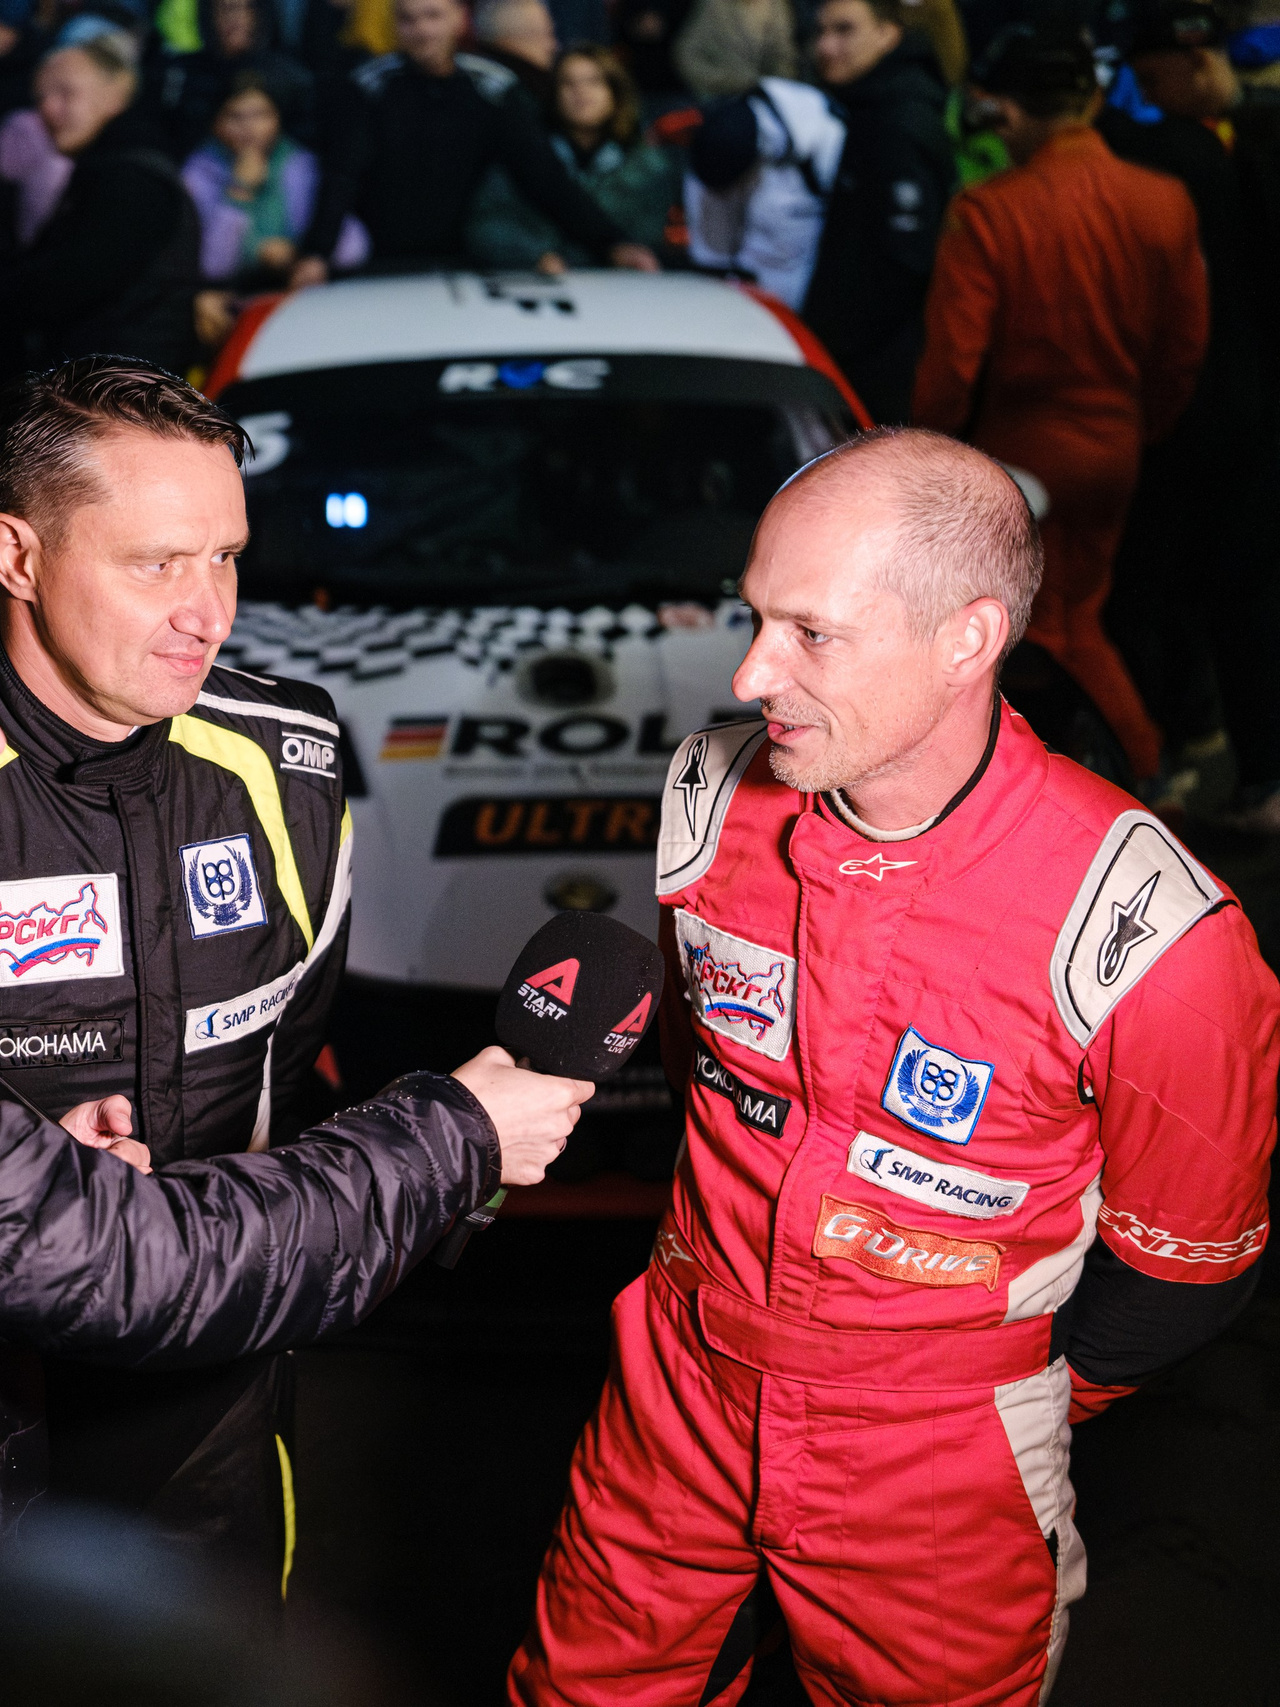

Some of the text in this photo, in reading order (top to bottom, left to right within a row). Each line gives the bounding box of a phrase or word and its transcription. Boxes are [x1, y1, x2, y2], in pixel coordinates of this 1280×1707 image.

[282, 737, 335, 770] OMP
[476, 802, 660, 844] ULTR
[700, 961, 762, 1000] РСКГ
[222, 1004, 256, 1031] SMP
[517, 983, 567, 1021] START
[523, 1000, 546, 1018] LIVE
[608, 1045, 624, 1054] LIVE
[696, 1050, 777, 1128] YOKOAMA
[888, 1160, 1013, 1208] SMP RACING
